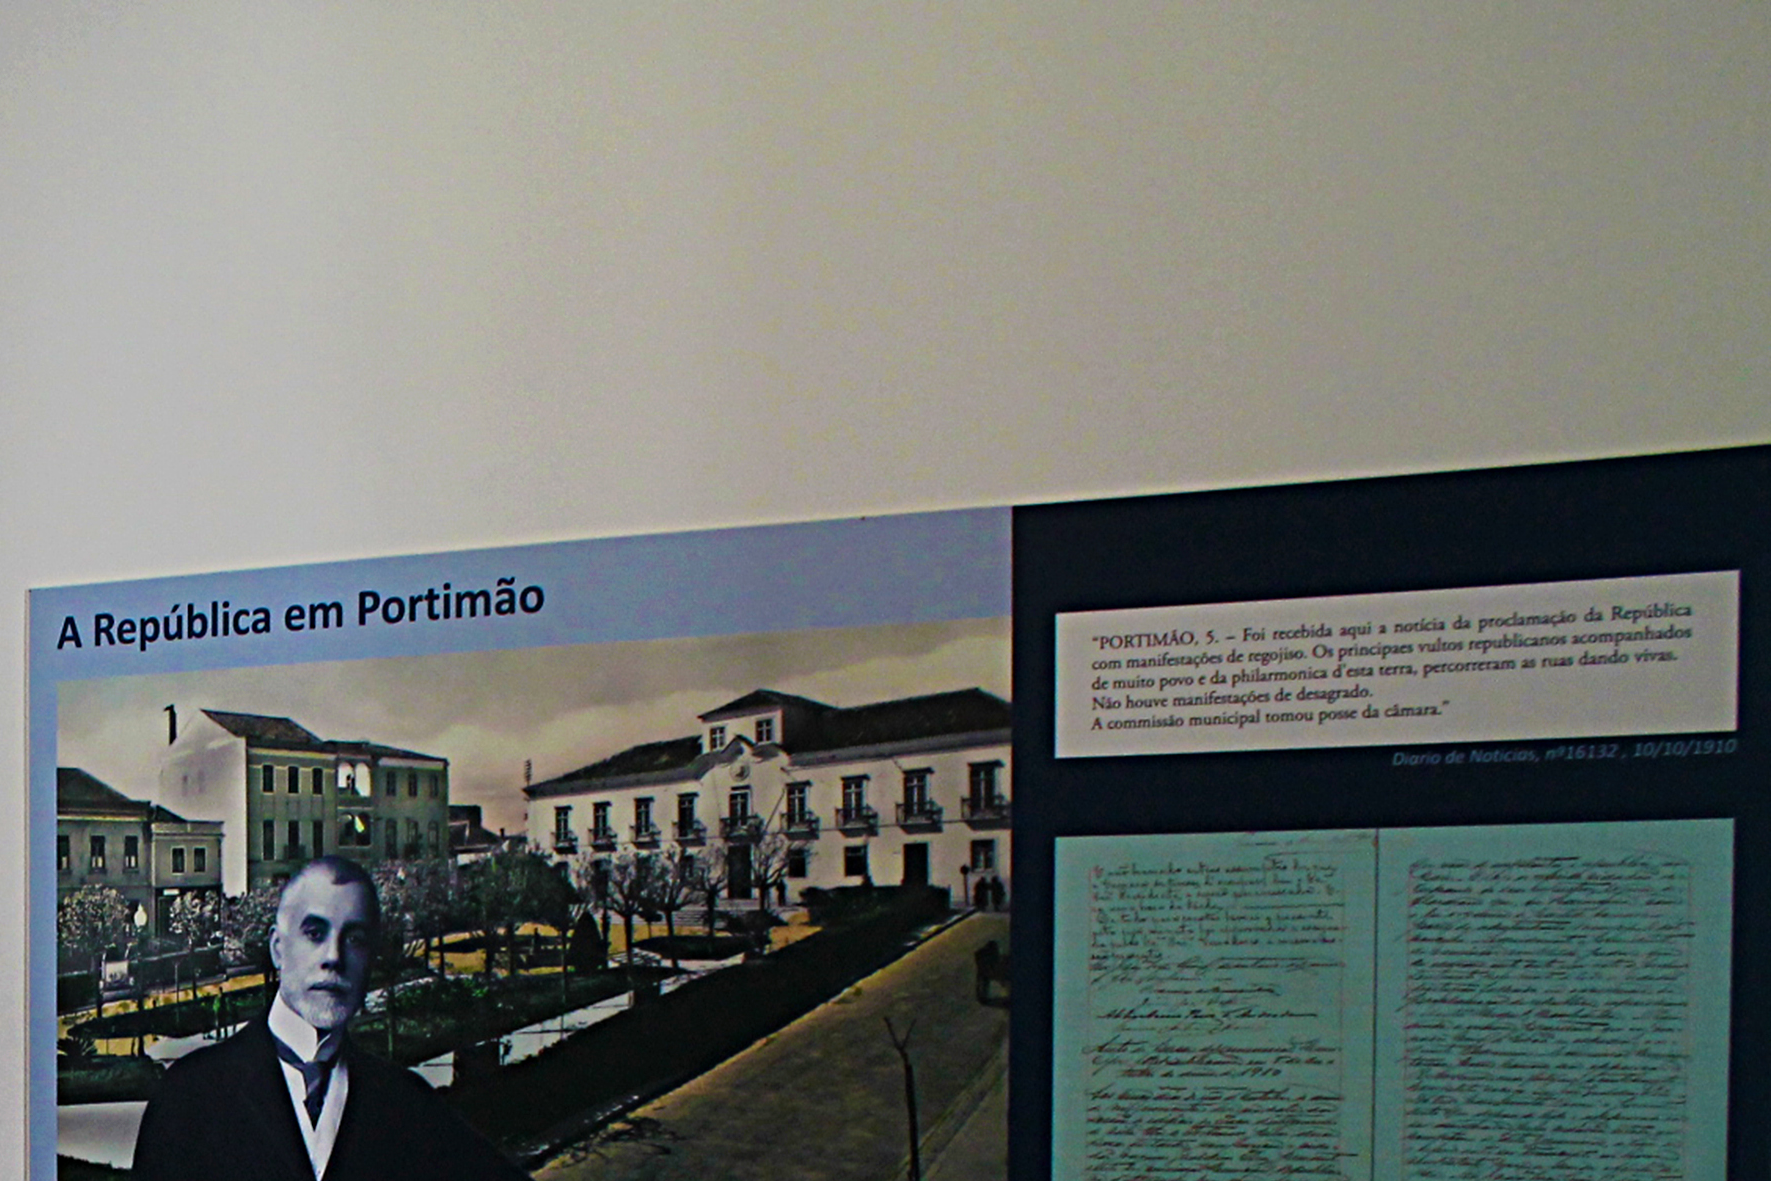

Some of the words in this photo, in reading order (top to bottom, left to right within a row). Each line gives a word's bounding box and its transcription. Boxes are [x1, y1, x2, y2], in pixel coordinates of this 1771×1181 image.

[57, 615, 83, 650] A
[94, 601, 272, 653] República
[285, 600, 344, 630] em
[357, 576, 546, 626] Portimão
[1206, 628, 1218, 643] 5.
[1242, 625, 1265, 641] Foi
[1272, 622, 1332, 639] recebida
[1339, 620, 1371, 640] aqui
[1378, 624, 1386, 634] a
[1393, 616, 1445, 633] notícia
[1452, 615, 1471, 630] da
[1478, 609, 1576, 633] proclamação
[1583, 608, 1603, 623] da
[1611, 603, 1692, 626] República
[1091, 658, 1121, 669] com
[1126, 648, 1222, 672] manifestações
[1226, 647, 1243, 662] de
[1311, 642, 1333, 658] Os
[1338, 638, 1413, 660] principaes
[1417, 635, 1463, 652] vultos
[1468, 630, 1566, 654] republicanos
[1571, 623, 1692, 648] acompanhados
